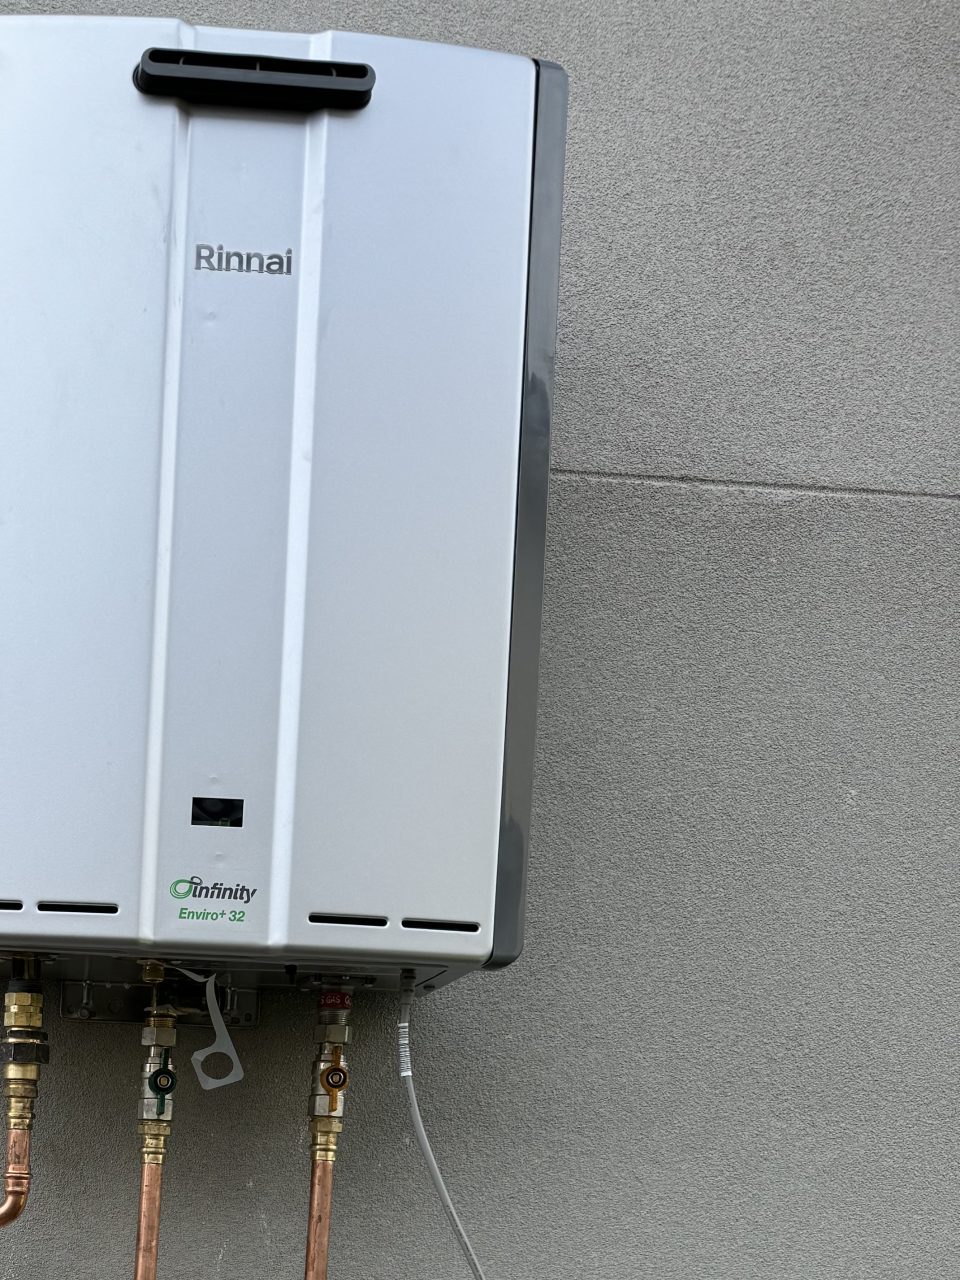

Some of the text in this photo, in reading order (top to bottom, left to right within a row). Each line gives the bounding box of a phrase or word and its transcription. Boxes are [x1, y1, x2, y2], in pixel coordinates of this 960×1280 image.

[194, 243, 292, 275] Rinnai
[189, 876, 257, 904] infinity
[228, 910, 246, 922] 32
